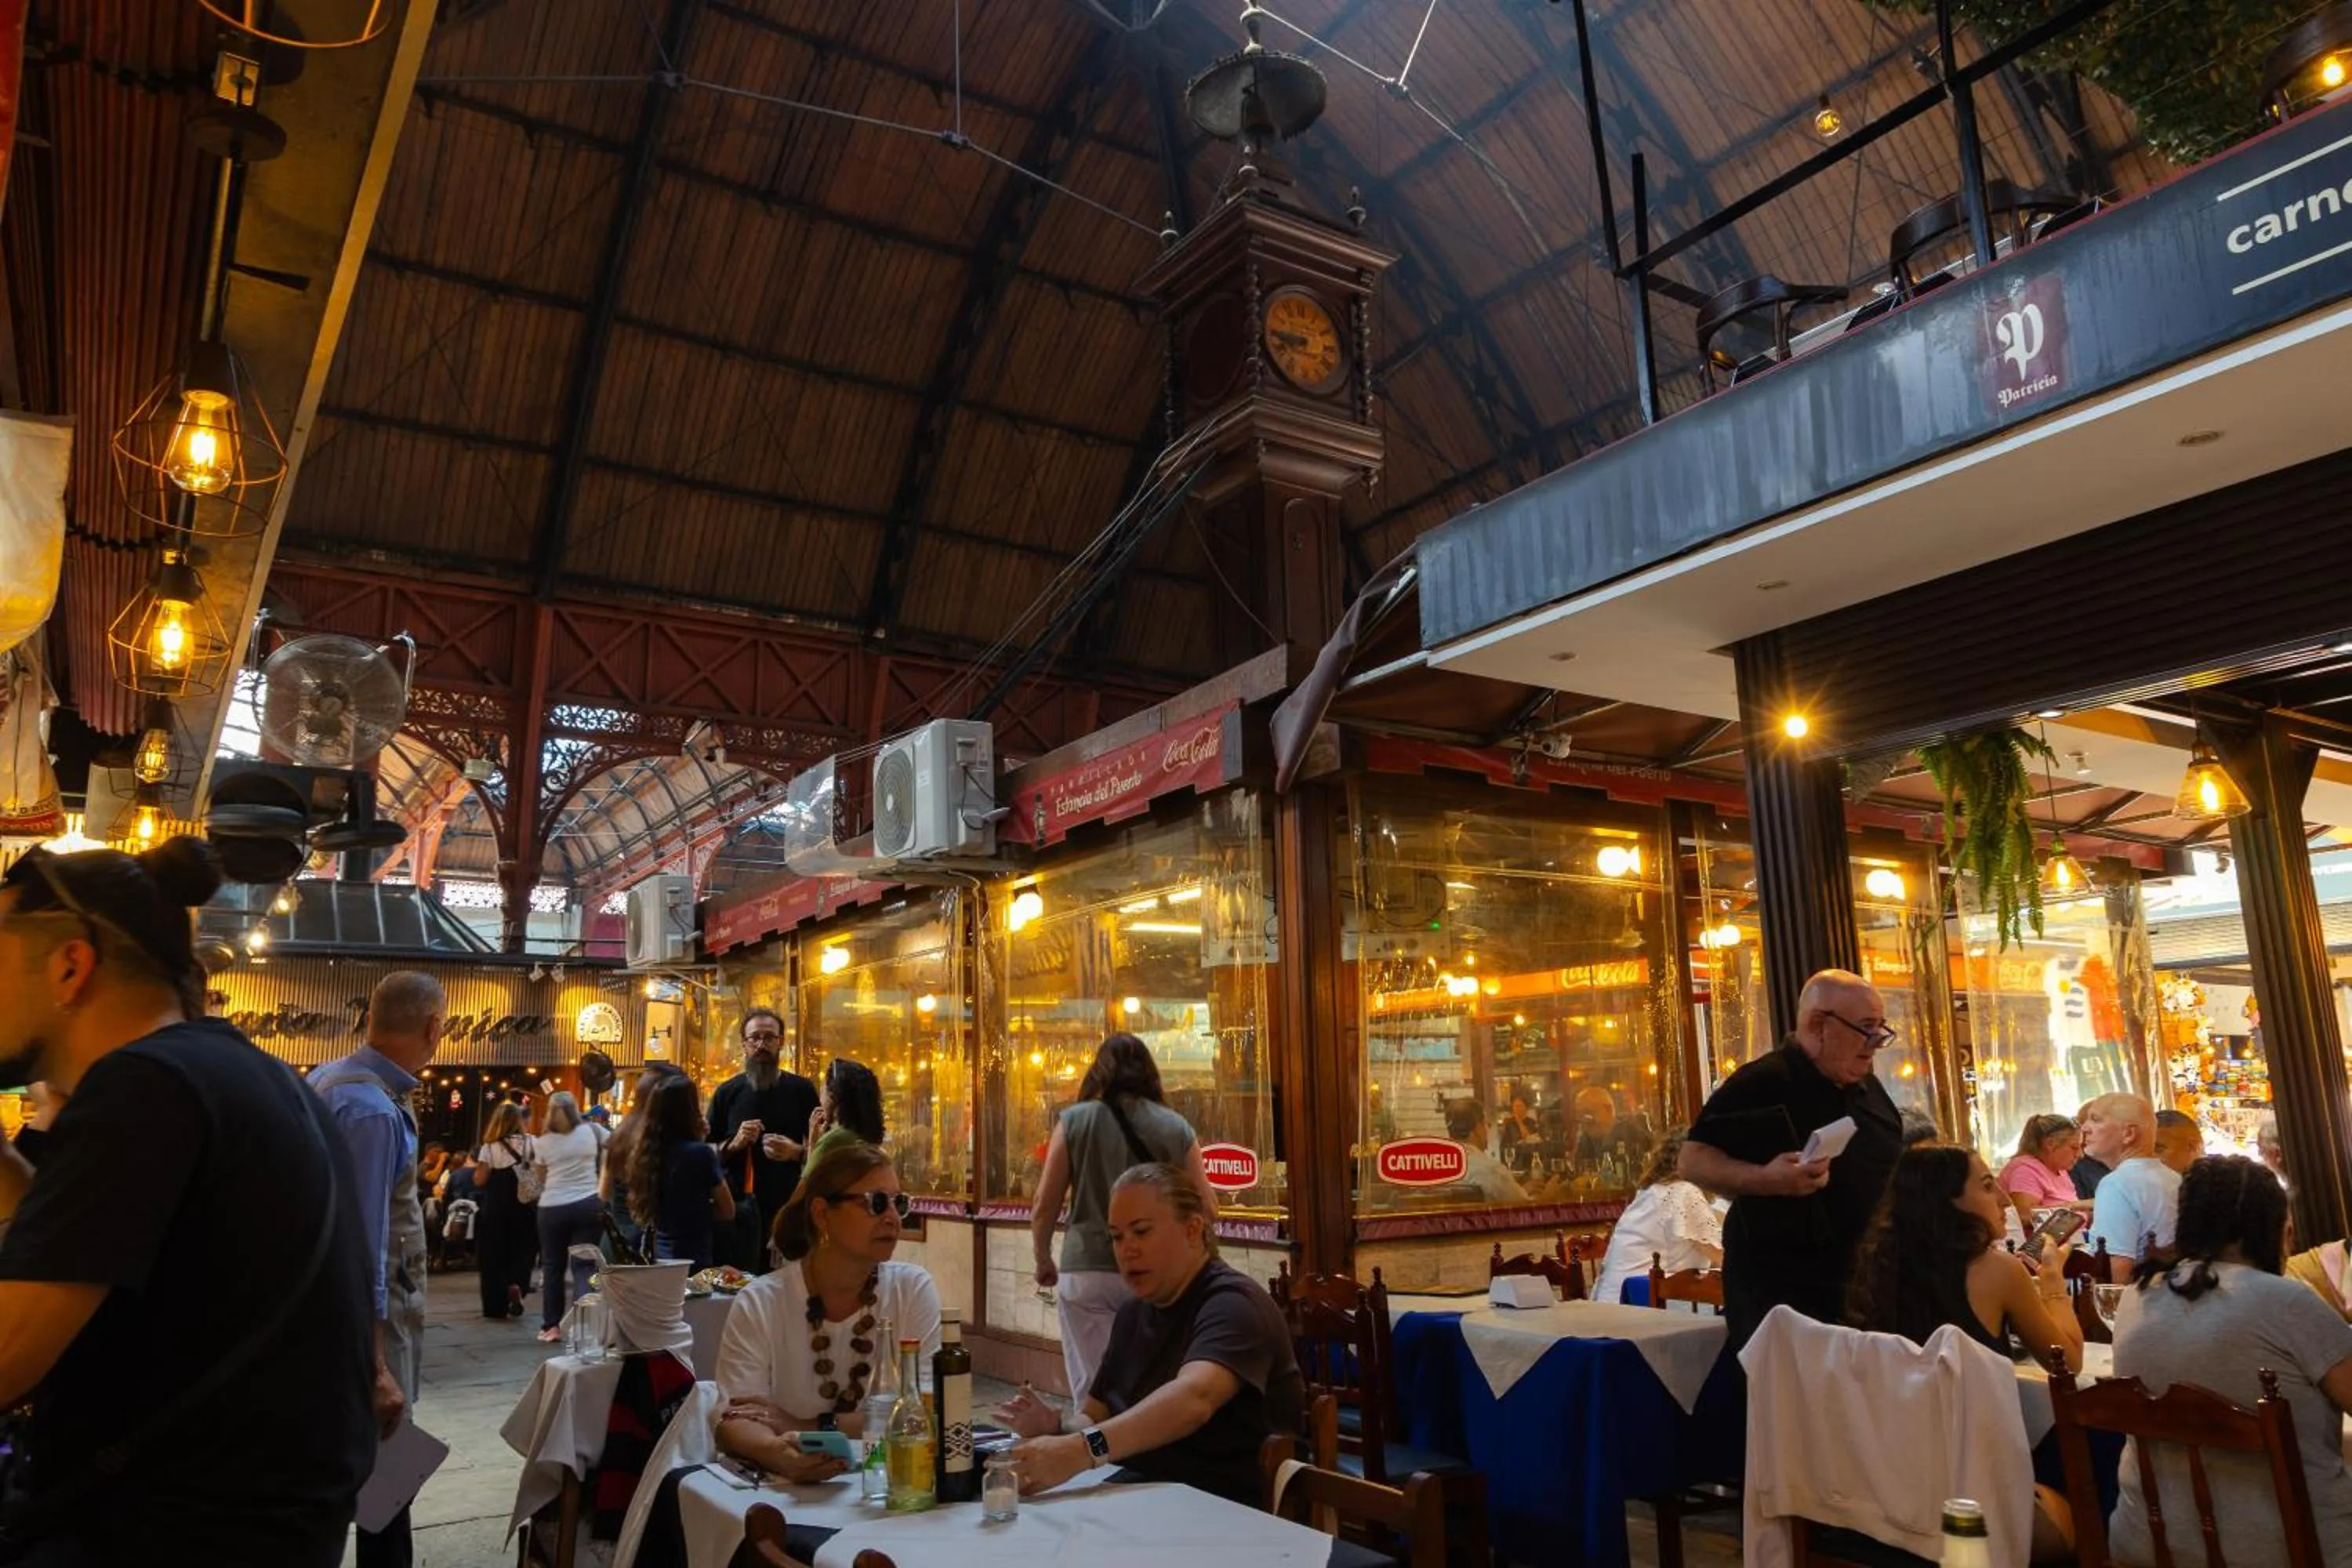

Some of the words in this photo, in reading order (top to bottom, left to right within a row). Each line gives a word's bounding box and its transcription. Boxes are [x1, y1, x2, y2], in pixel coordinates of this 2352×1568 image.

[1998, 375, 2058, 408] Patricia
[1094, 780, 1109, 802] del
[1109, 769, 1142, 797] Puerto
[1387, 1152, 1457, 1171] CATTIVELLI
